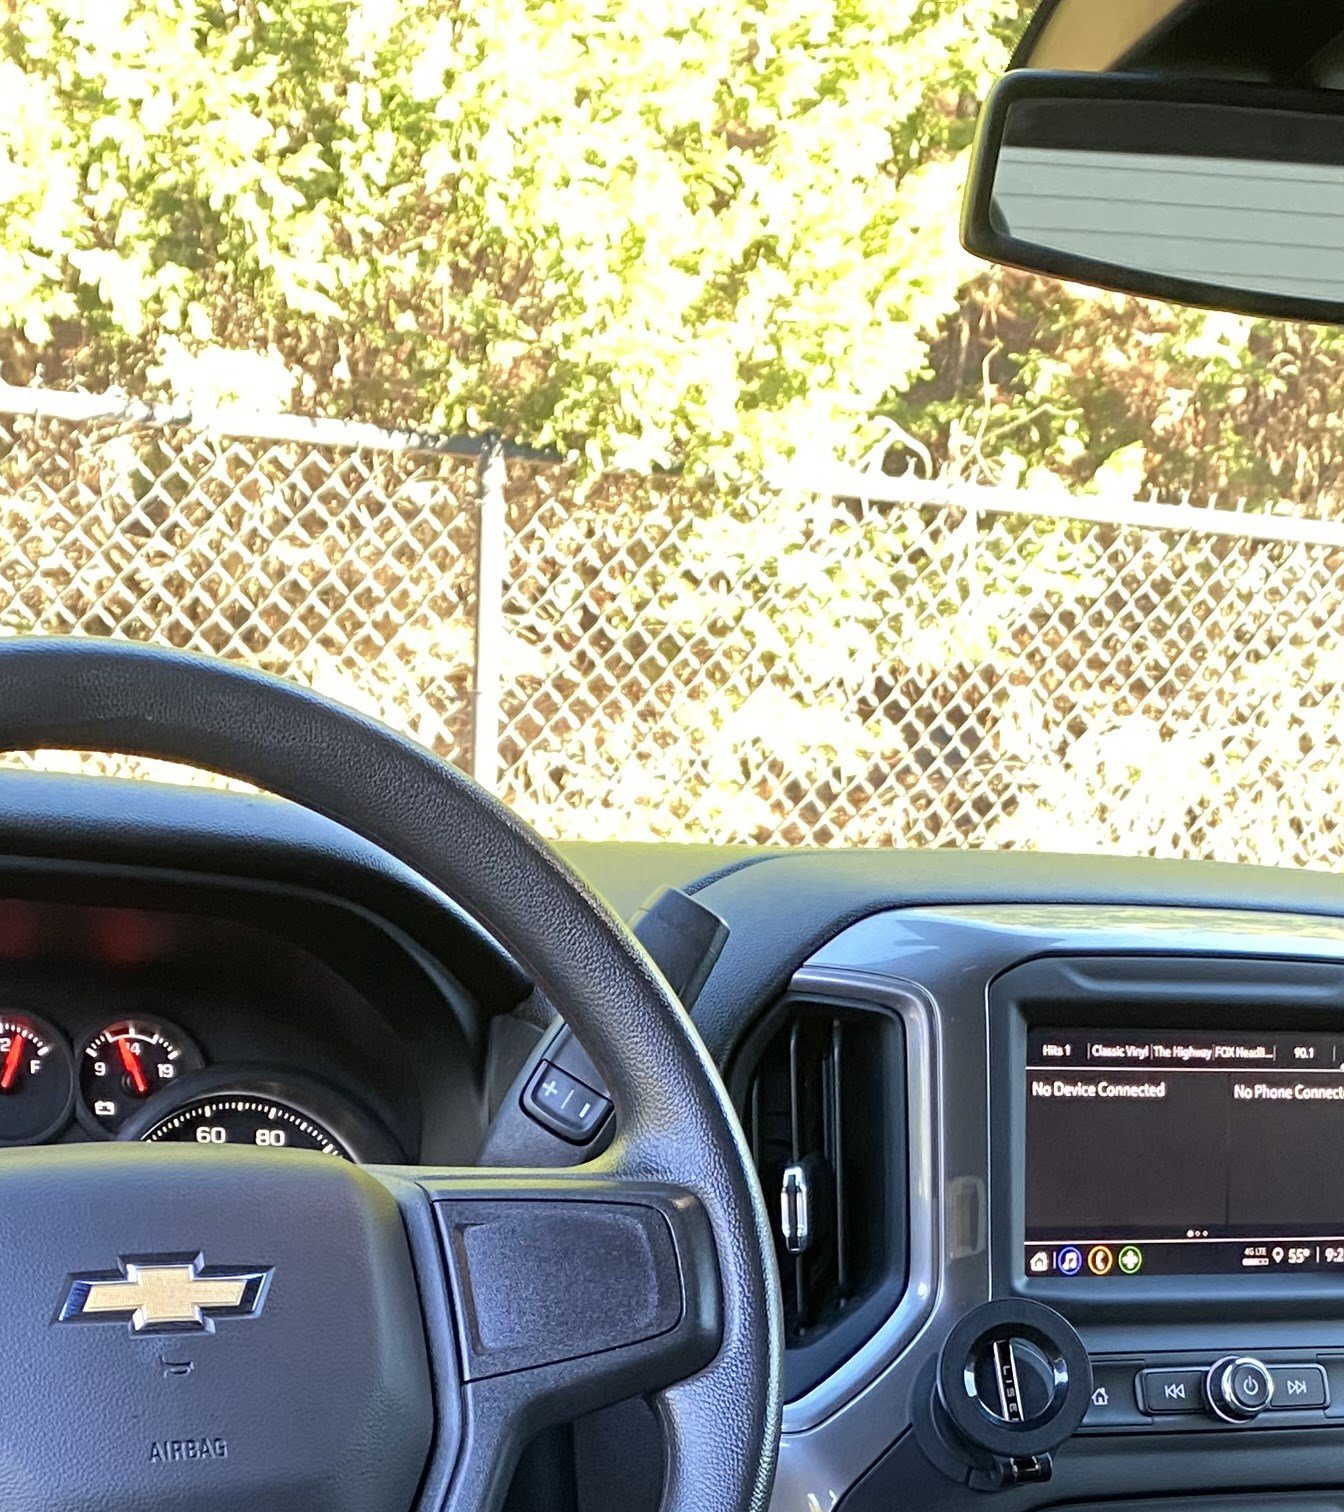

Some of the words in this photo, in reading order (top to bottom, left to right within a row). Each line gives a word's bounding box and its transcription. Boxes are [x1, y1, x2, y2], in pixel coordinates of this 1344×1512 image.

[1042, 1044, 1064, 1056] Hits
[1091, 1044, 1125, 1057] Classic
[1126, 1044, 1149, 1060] Vinyl
[1153, 1045, 1172, 1057] The
[1172, 1045, 1213, 1061] Highway
[1215, 1046, 1235, 1058] FOX
[30, 1059, 42, 1075] F
[94, 1061, 107, 1077] 9
[156, 1063, 175, 1079] 19
[1031, 1081, 1052, 1097] No
[1053, 1081, 1097, 1097] Device
[1097, 1081, 1166, 1097] Connected
[1233, 1084, 1253, 1099] No
[1254, 1084, 1294, 1100] Phone
[195, 1126, 227, 1145] 60
[255, 1129, 286, 1147] 80
[1002, 1365, 1020, 1422] LISE
[148, 1437, 228, 1463] AIRBAG
